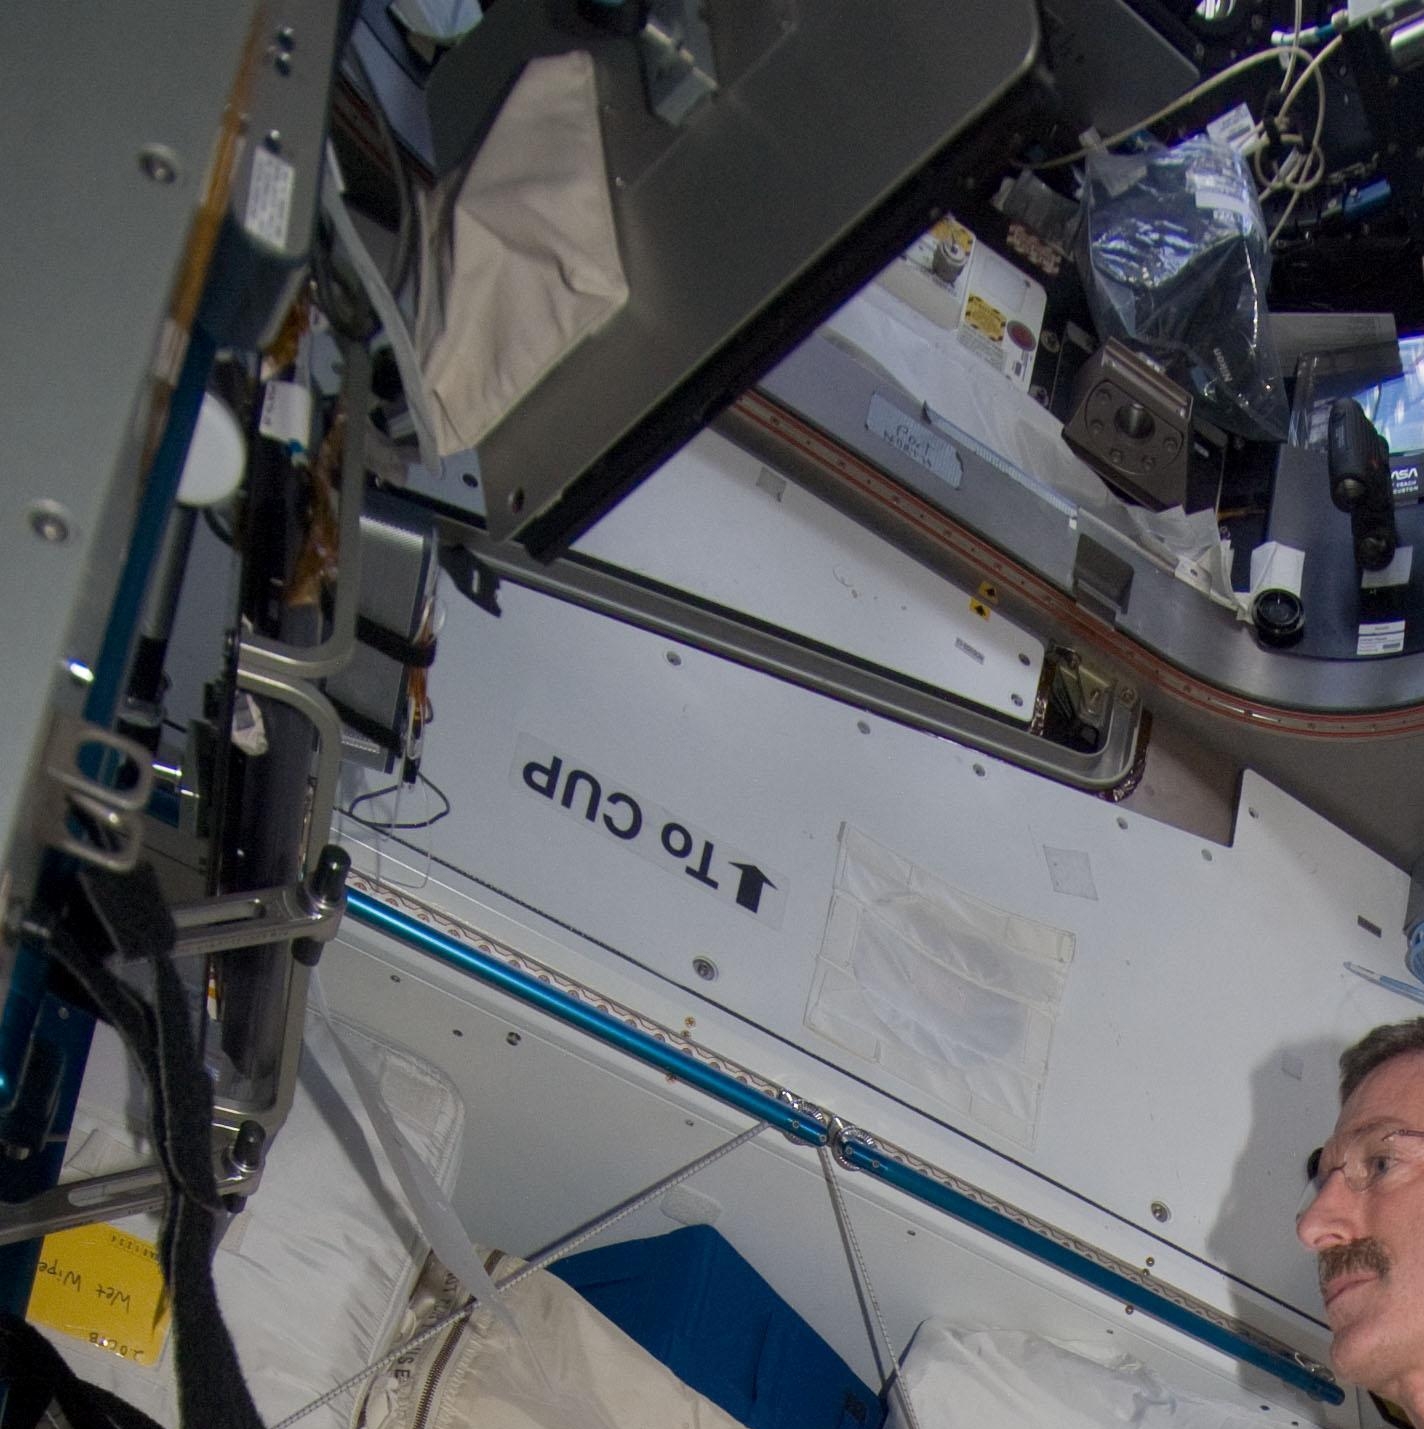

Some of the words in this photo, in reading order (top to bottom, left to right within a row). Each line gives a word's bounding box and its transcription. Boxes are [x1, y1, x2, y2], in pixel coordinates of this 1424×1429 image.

[1390, 467, 1419, 481] ASA
[522, 755, 643, 841] CUP
[660, 822, 720, 890] To
[95, 1282, 132, 1314] Wet
